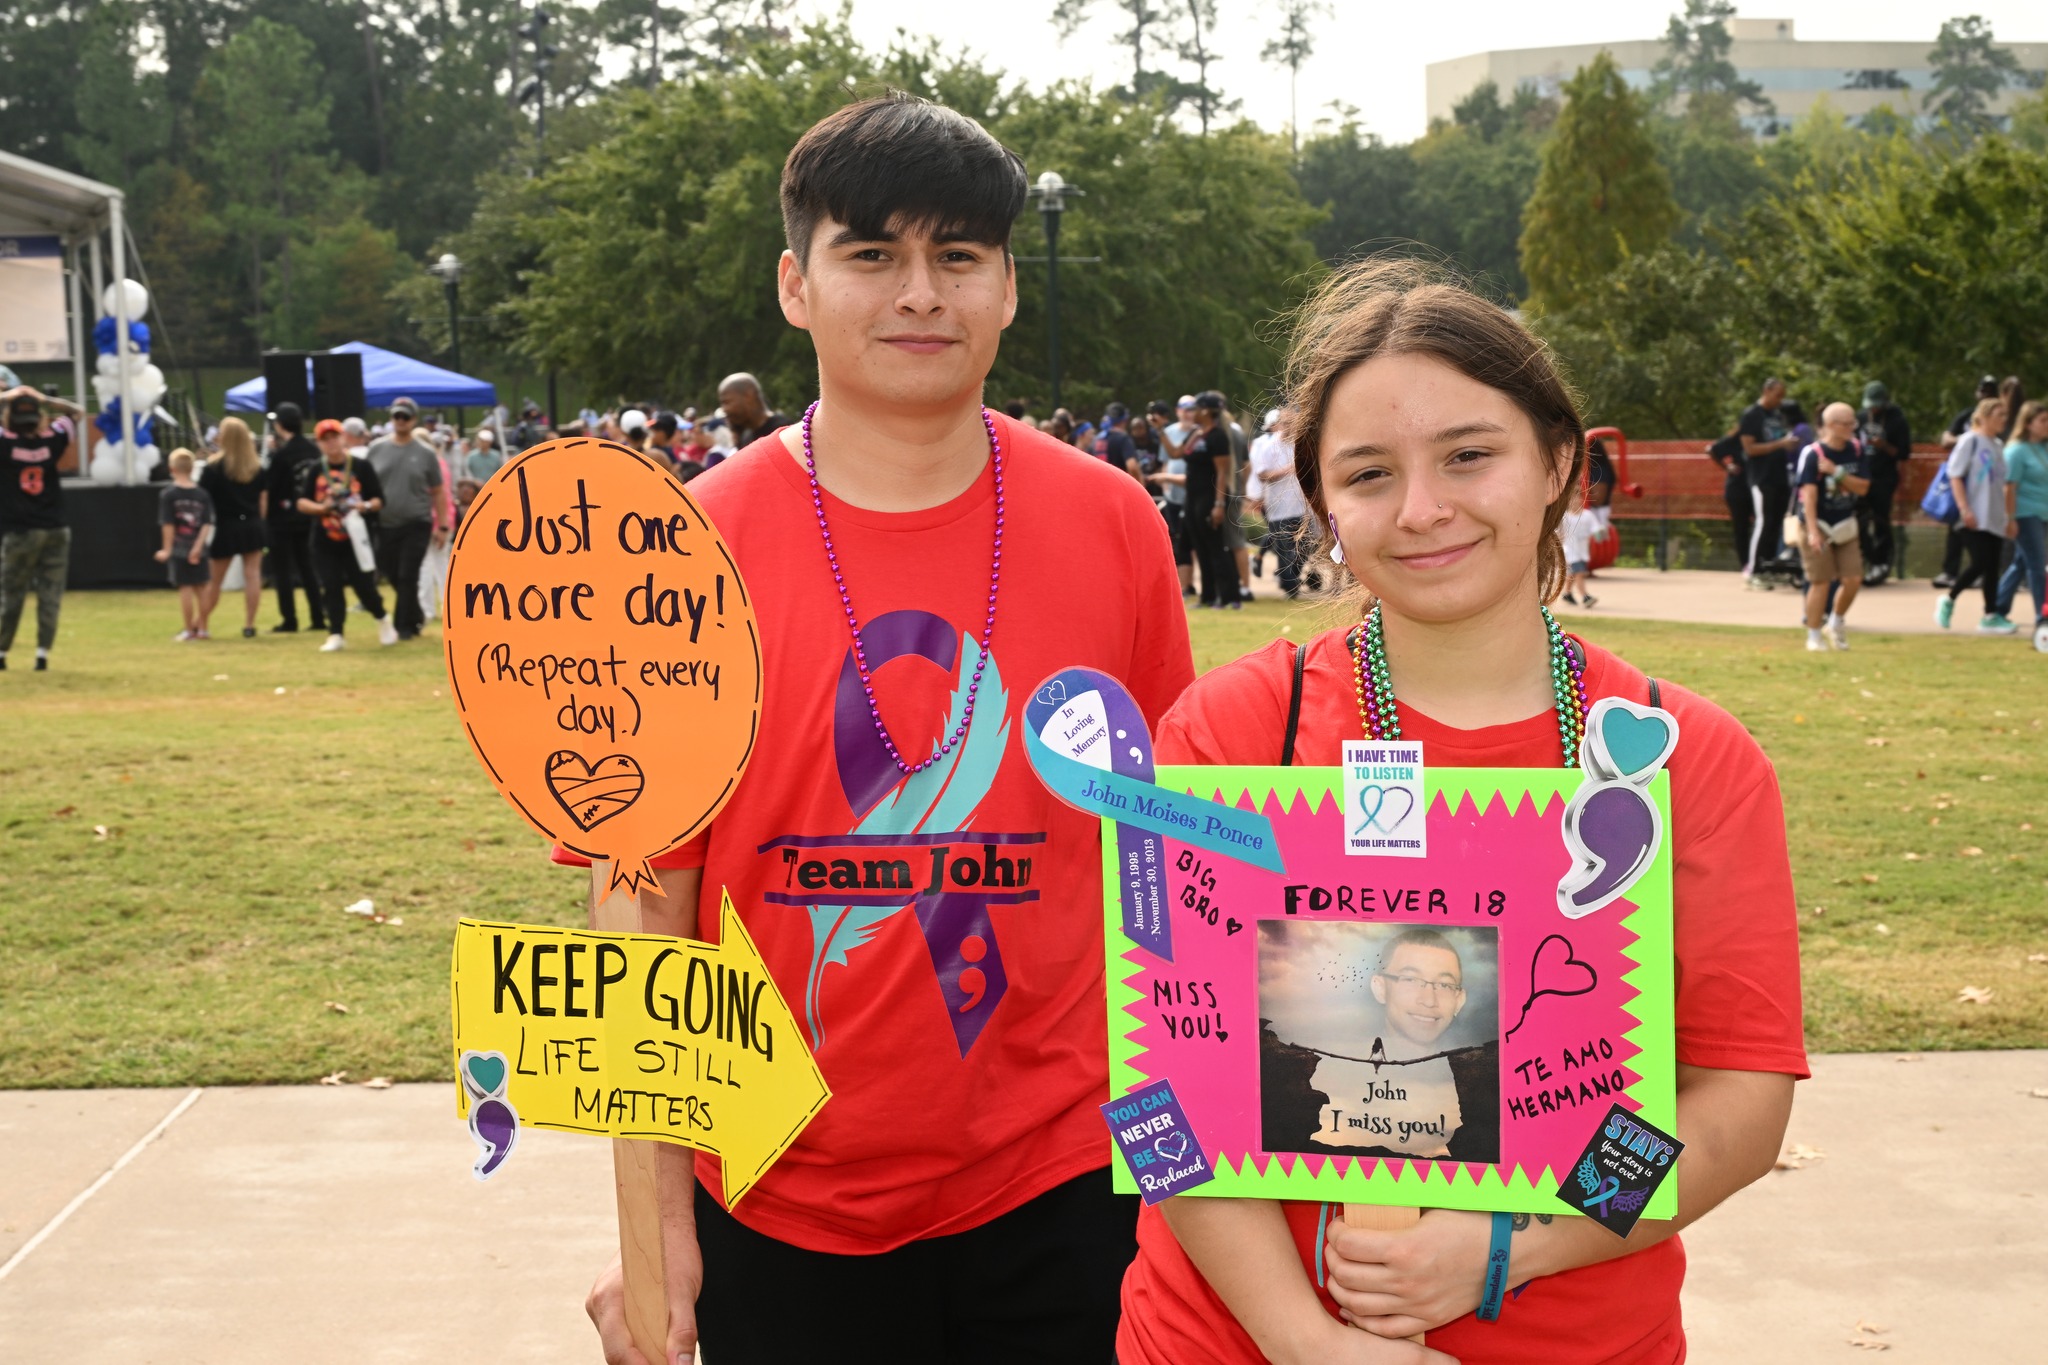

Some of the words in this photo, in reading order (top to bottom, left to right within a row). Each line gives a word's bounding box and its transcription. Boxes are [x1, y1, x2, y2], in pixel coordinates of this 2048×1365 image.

[496, 466, 601, 555] Just
[618, 511, 692, 556] one
[465, 582, 594, 621] more
[625, 572, 725, 644] day!
[477, 643, 627, 700] (Repeat
[640, 660, 720, 701] every
[557, 687, 642, 743] day.)
[1062, 707, 1075, 720] In
[1063, 713, 1095, 741] Loving
[1071, 726, 1107, 757] Memory
[1347, 750, 1352, 763] I
[1355, 750, 1387, 763] HAVE
[1389, 750, 1419, 763] TIME
[1354, 766, 1370, 780] TO
[1373, 767, 1414, 780] LISTEN
[1081, 779, 1128, 810] John
[1132, 794, 1198, 831] Moises
[1204, 815, 1264, 850] Ponce
[1144, 838, 1155, 863] 2013
[1350, 839, 1371, 848] YOUR
[1372, 839, 1386, 848] LIFE
[1387, 839, 1421, 849] MATTERS
[782, 847, 913, 890] Team
[922, 844, 1033, 896] John
[1128, 851, 1140, 876] 1995
[1147, 866, 1157, 882] 30,
[1175, 849, 1217, 892] BIG
[1130, 878, 1141, 889] 9,
[1284, 884, 1448, 915] FOREVER
[1474, 890, 1506, 917] 18
[1133, 889, 1144, 930] January
[1148, 885, 1161, 935] November
[1180, 884, 1219, 926] BRO
[493, 934, 627, 1020] KEEP
[644, 948, 774, 1063] GOING
[1153, 979, 1217, 1009] MISS
[1161, 1012, 1229, 1043] YOU!
[516, 1026, 600, 1077] LIFE
[634, 1039, 742, 1090] STILL
[1514, 1056, 1553, 1086] TE
[1563, 1037, 1613, 1072] AMO
[574, 1087, 715, 1131] MATTERS
[1108, 1103, 1141, 1125] YOU
[1140, 1089, 1173, 1113] CAN
[1362, 1079, 1408, 1104] John
[1507, 1069, 1625, 1121] HERMANO
[1120, 1112, 1175, 1146] NEVER
[1331, 1109, 1343, 1133] I
[1347, 1113, 1392, 1135] miss
[1397, 1114, 1446, 1144] you!
[1132, 1147, 1157, 1169] BE
[1140, 1155, 1205, 1194] Replaced
[1600, 1140, 1622, 1158] Your
[1621, 1156, 1645, 1174] story
[1644, 1168, 1654, 1177] is
[1603, 1158, 1620, 1170] not
[1618, 1167, 1638, 1180] over
[1485, 1264, 1503, 1306] Foundation
